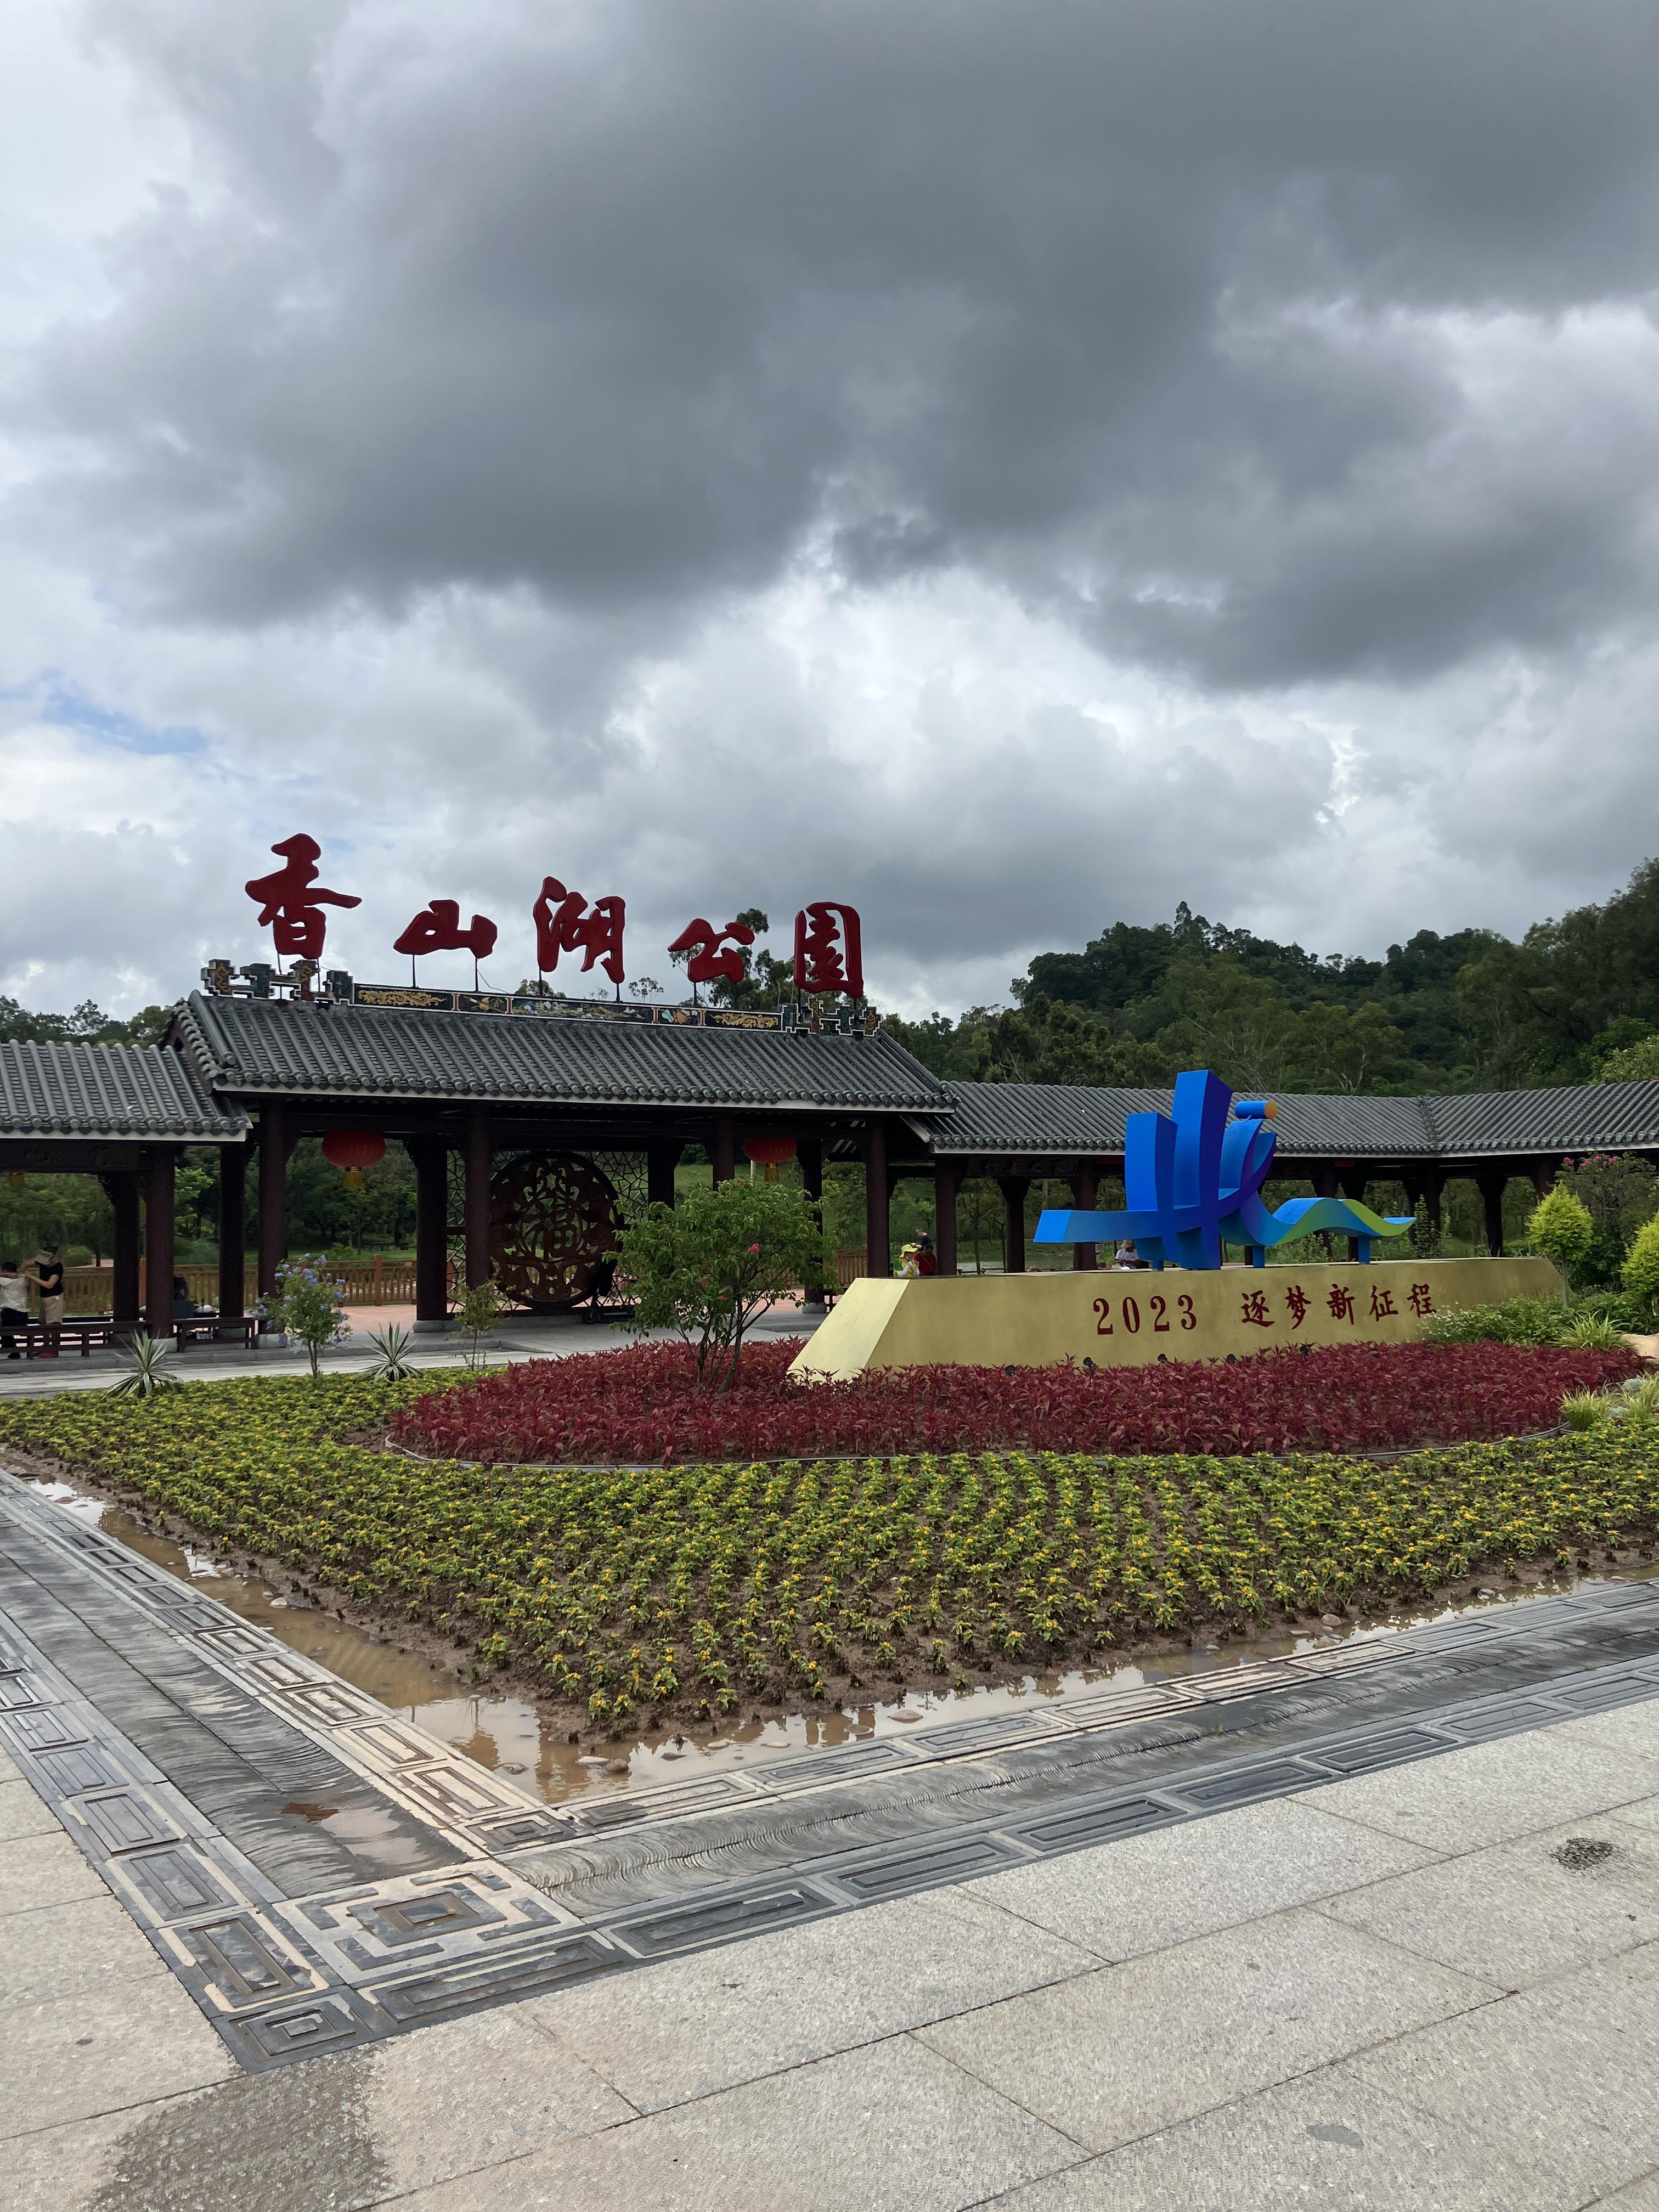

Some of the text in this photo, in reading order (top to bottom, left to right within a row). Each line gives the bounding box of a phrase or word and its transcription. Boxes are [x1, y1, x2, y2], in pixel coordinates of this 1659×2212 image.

[523, 1199, 579, 1260] 福
[1092, 1283, 1437, 1335] 2023 逐梦新征程
